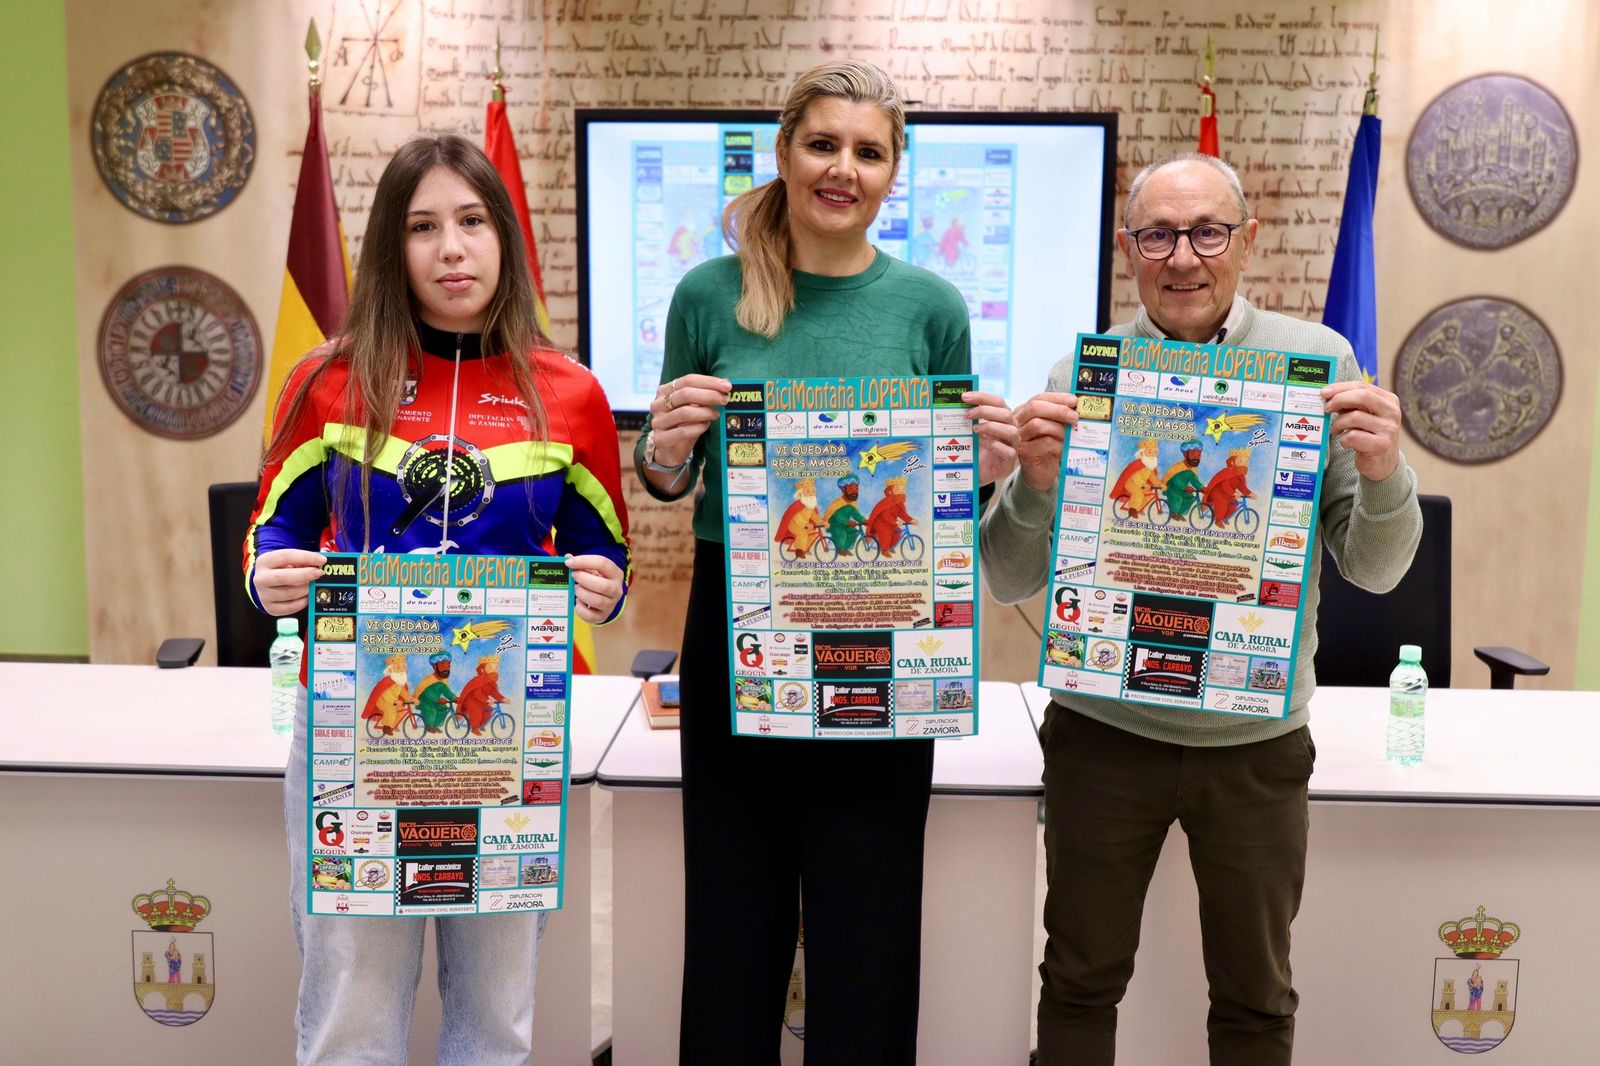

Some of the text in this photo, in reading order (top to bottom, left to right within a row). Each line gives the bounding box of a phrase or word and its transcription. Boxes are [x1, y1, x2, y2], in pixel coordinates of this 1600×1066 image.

[1082, 344, 1118, 358] LOYMA
[1213, 347, 1287, 382] LOPENTA
[860, 377, 930, 408] LOPENTA
[478, 393, 530, 409] Spiuk
[1122, 402, 1193, 419] VI QUEDADA
[478, 420, 511, 428] ZAMORA
[1117, 415, 1196, 432] REYES MAGOS
[775, 443, 845, 455] VI QUEDADA
[772, 458, 849, 468] REYES MAGOS
[1062, 503, 1078, 514] GARAJE
[1124, 520, 1181, 533] ESPERAMOS
[1182, 526, 1196, 534] EN
[1199, 528, 1255, 541] BENAVENTE
[868, 559, 922, 567] BENAVENTE
[323, 564, 355, 576] OYMA
[455, 556, 526, 586] LOPENTA
[1069, 568, 1093, 578] FUENTE
[746, 612, 769, 624] FUENTE
[1132, 610, 1210, 634] VAQUERO
[366, 620, 438, 630] VI QUEDADA
[1049, 622, 1081, 632] GEQUIN
[362, 634, 442, 644] REYES MAGOS
[1214, 629, 1291, 648] CAJA RURAL
[1241, 643, 1277, 654] ZAMORA
[815, 648, 890, 663] VAQUERO
[896, 656, 971, 668] CAJA RURAL
[1162, 661, 1193, 673] CARBAYO
[850, 695, 879, 704] CARBAYO
[1230, 702, 1270, 715] ZAMORA
[314, 728, 330, 738] GARAJE
[923, 725, 960, 734] ZAMORA
[318, 790, 352, 806] LA FUENTE
[398, 825, 477, 841] VAQUERO
[482, 832, 558, 844] CAJA RURAL
[434, 871, 464, 880] CARBAYO
[506, 900, 544, 909] ZAMORA
